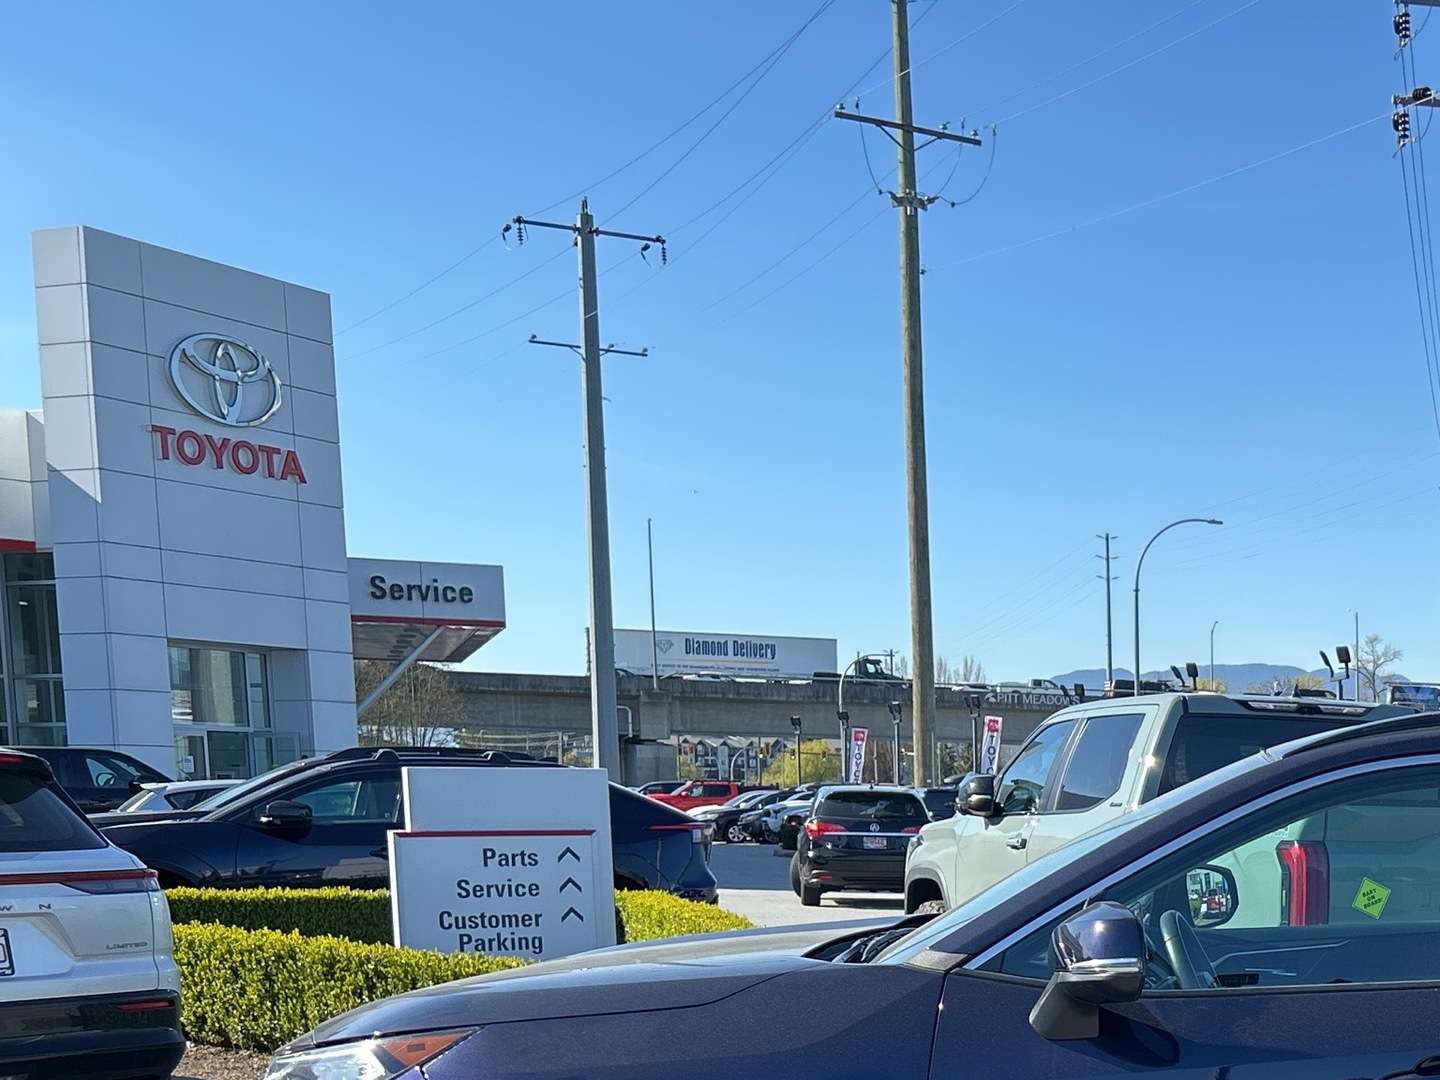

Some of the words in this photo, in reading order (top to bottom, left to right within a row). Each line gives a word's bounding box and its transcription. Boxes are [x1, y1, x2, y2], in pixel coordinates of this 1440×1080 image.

[150, 424, 307, 484] TOYOTA
[370, 575, 474, 603] Service
[684, 637, 728, 656] Diamond
[733, 640, 776, 660] Delivery
[997, 692, 1018, 704] PITT
[482, 848, 539, 867] Parts
[456, 878, 540, 899] Service
[439, 910, 543, 930] Customer
[458, 932, 543, 954] Parking
